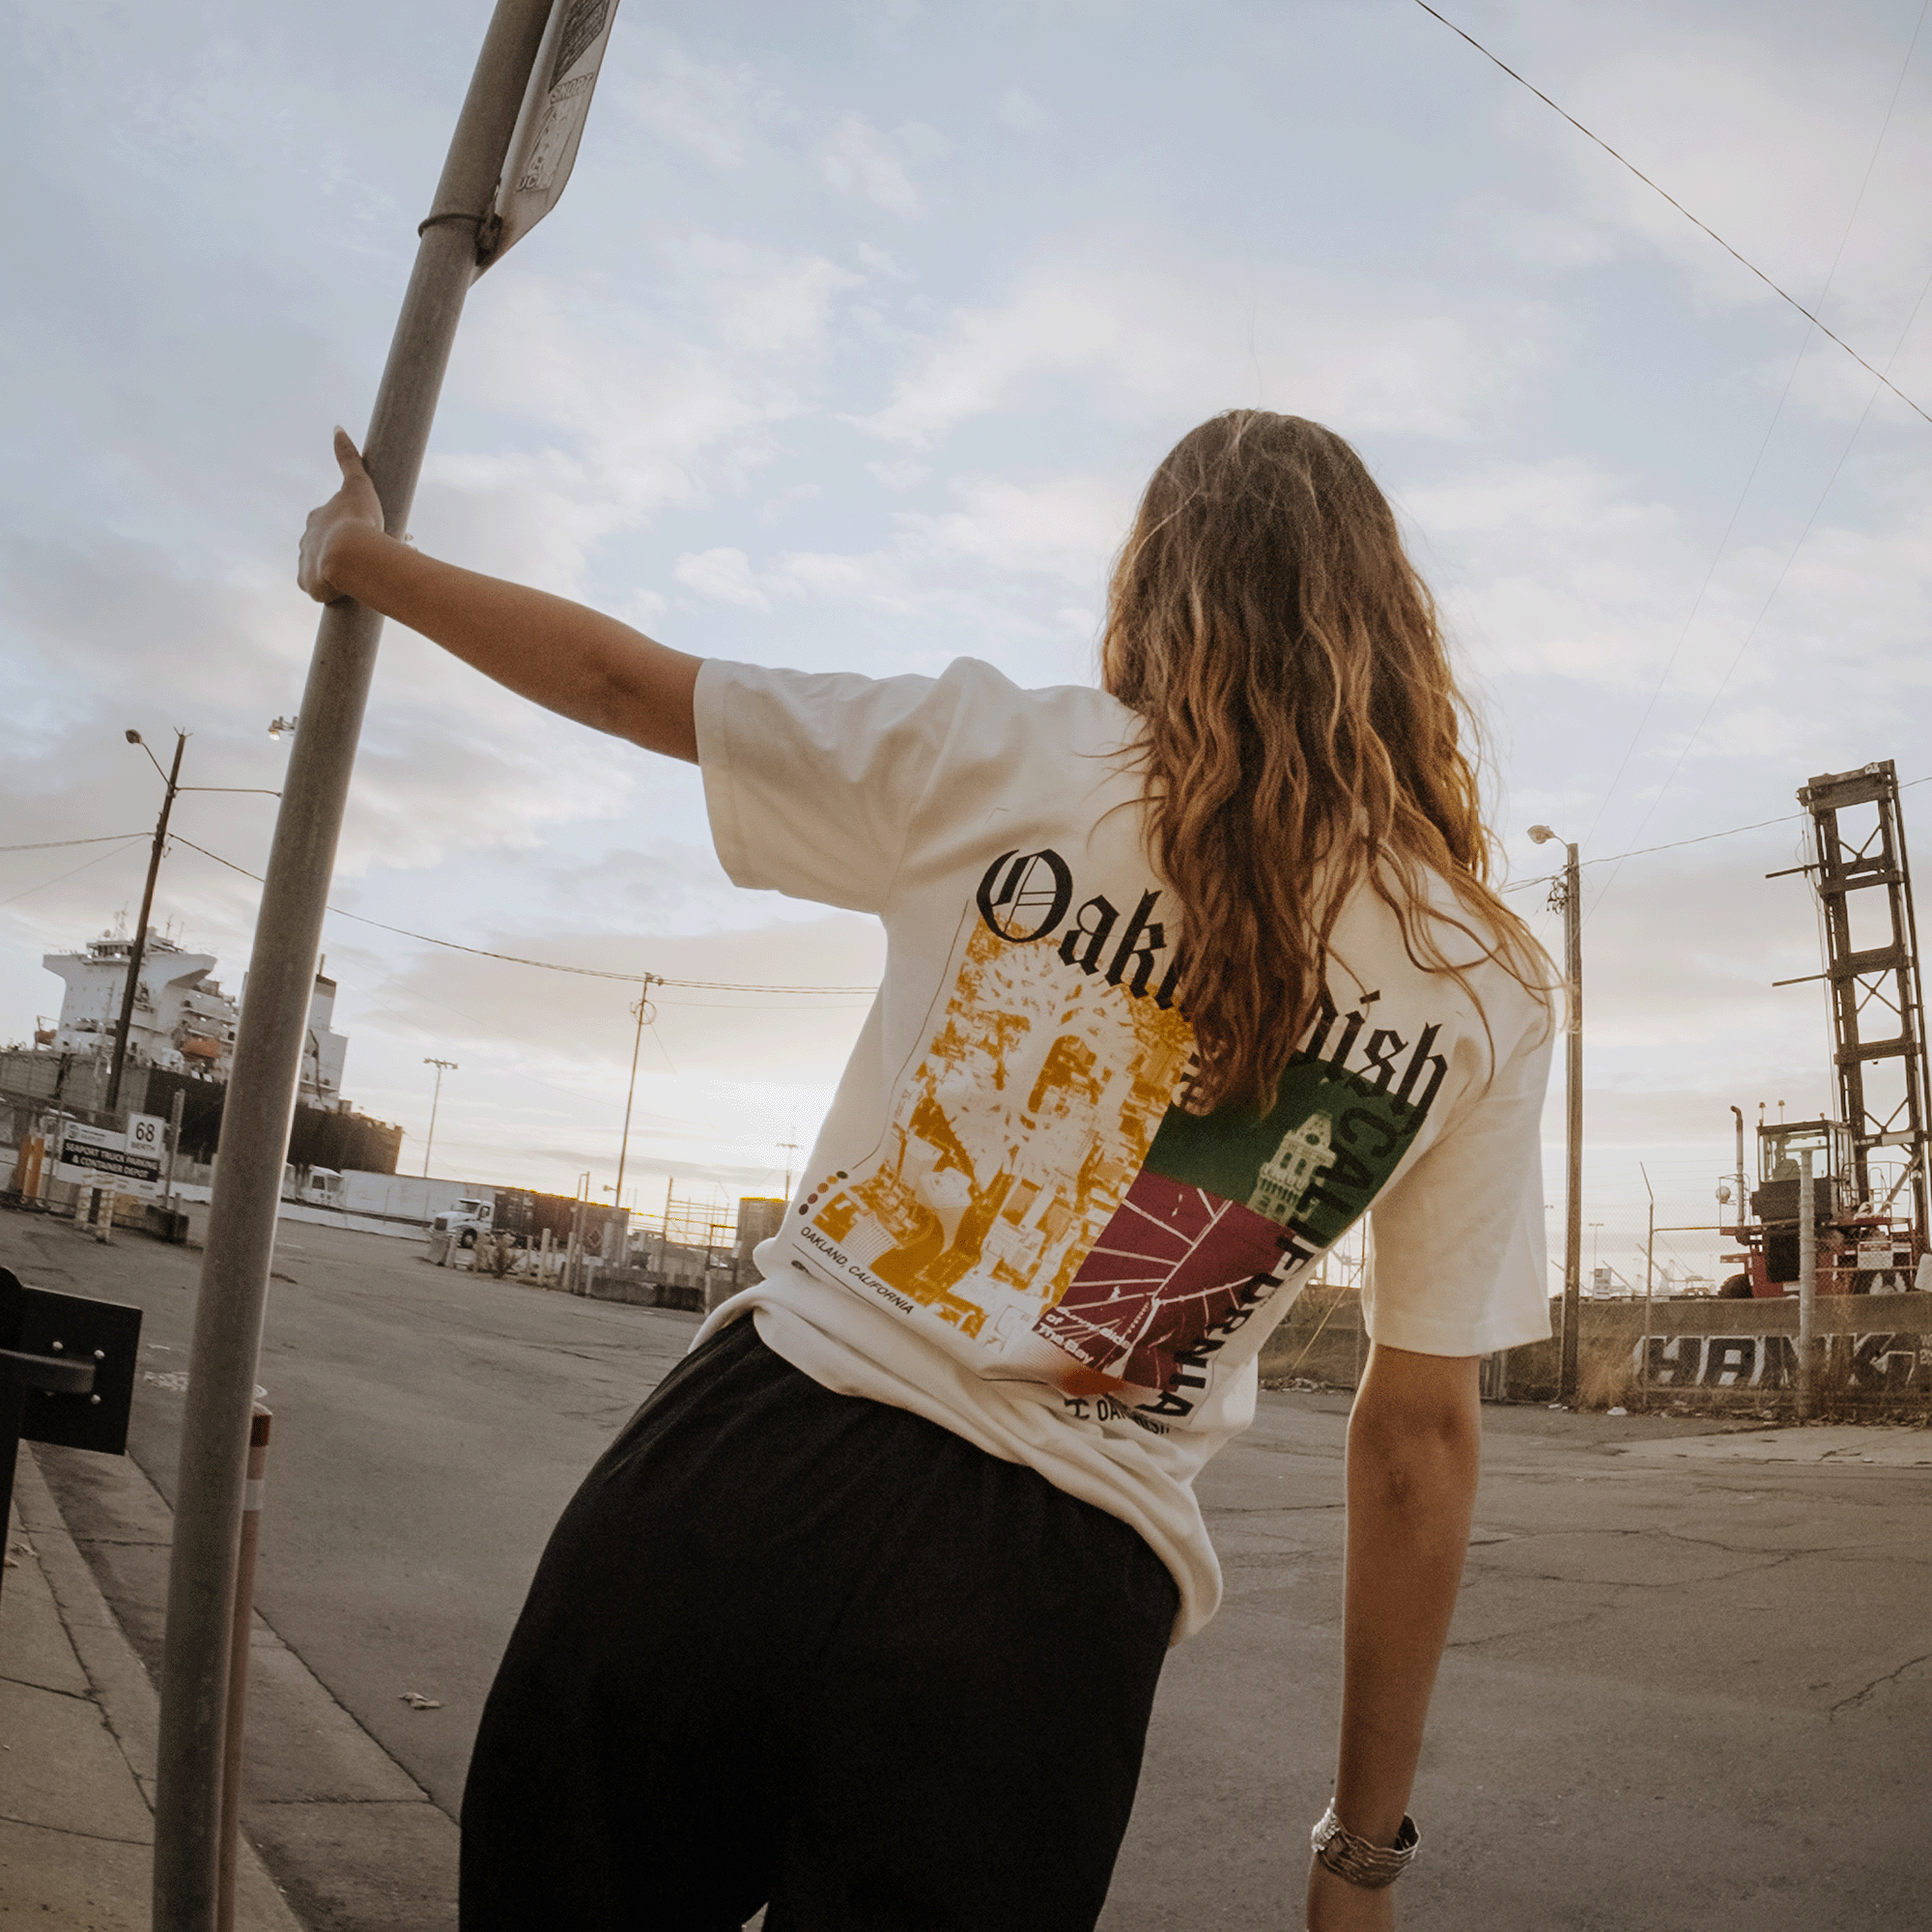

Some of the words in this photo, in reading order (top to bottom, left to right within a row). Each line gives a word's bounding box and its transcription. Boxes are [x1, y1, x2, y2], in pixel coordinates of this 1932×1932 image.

[135, 1122, 156, 1142] 68
[65, 1143, 99, 1156] SEAPORT
[100, 1150, 125, 1162] TRUCK
[126, 1156, 159, 1171] PARKING
[71, 1154, 79, 1163] &
[80, 1156, 124, 1173] CONTAINER
[124, 1166, 149, 1179] DEPOT
[800, 1226, 848, 1268] OAKLAND,
[848, 1265, 914, 1315] CALIFORNIA
[1045, 1313, 1065, 1325] of
[1038, 1321, 1065, 1346] The
[1064, 1338, 1094, 1364] Bay
[1098, 1326, 1131, 1350] Side
